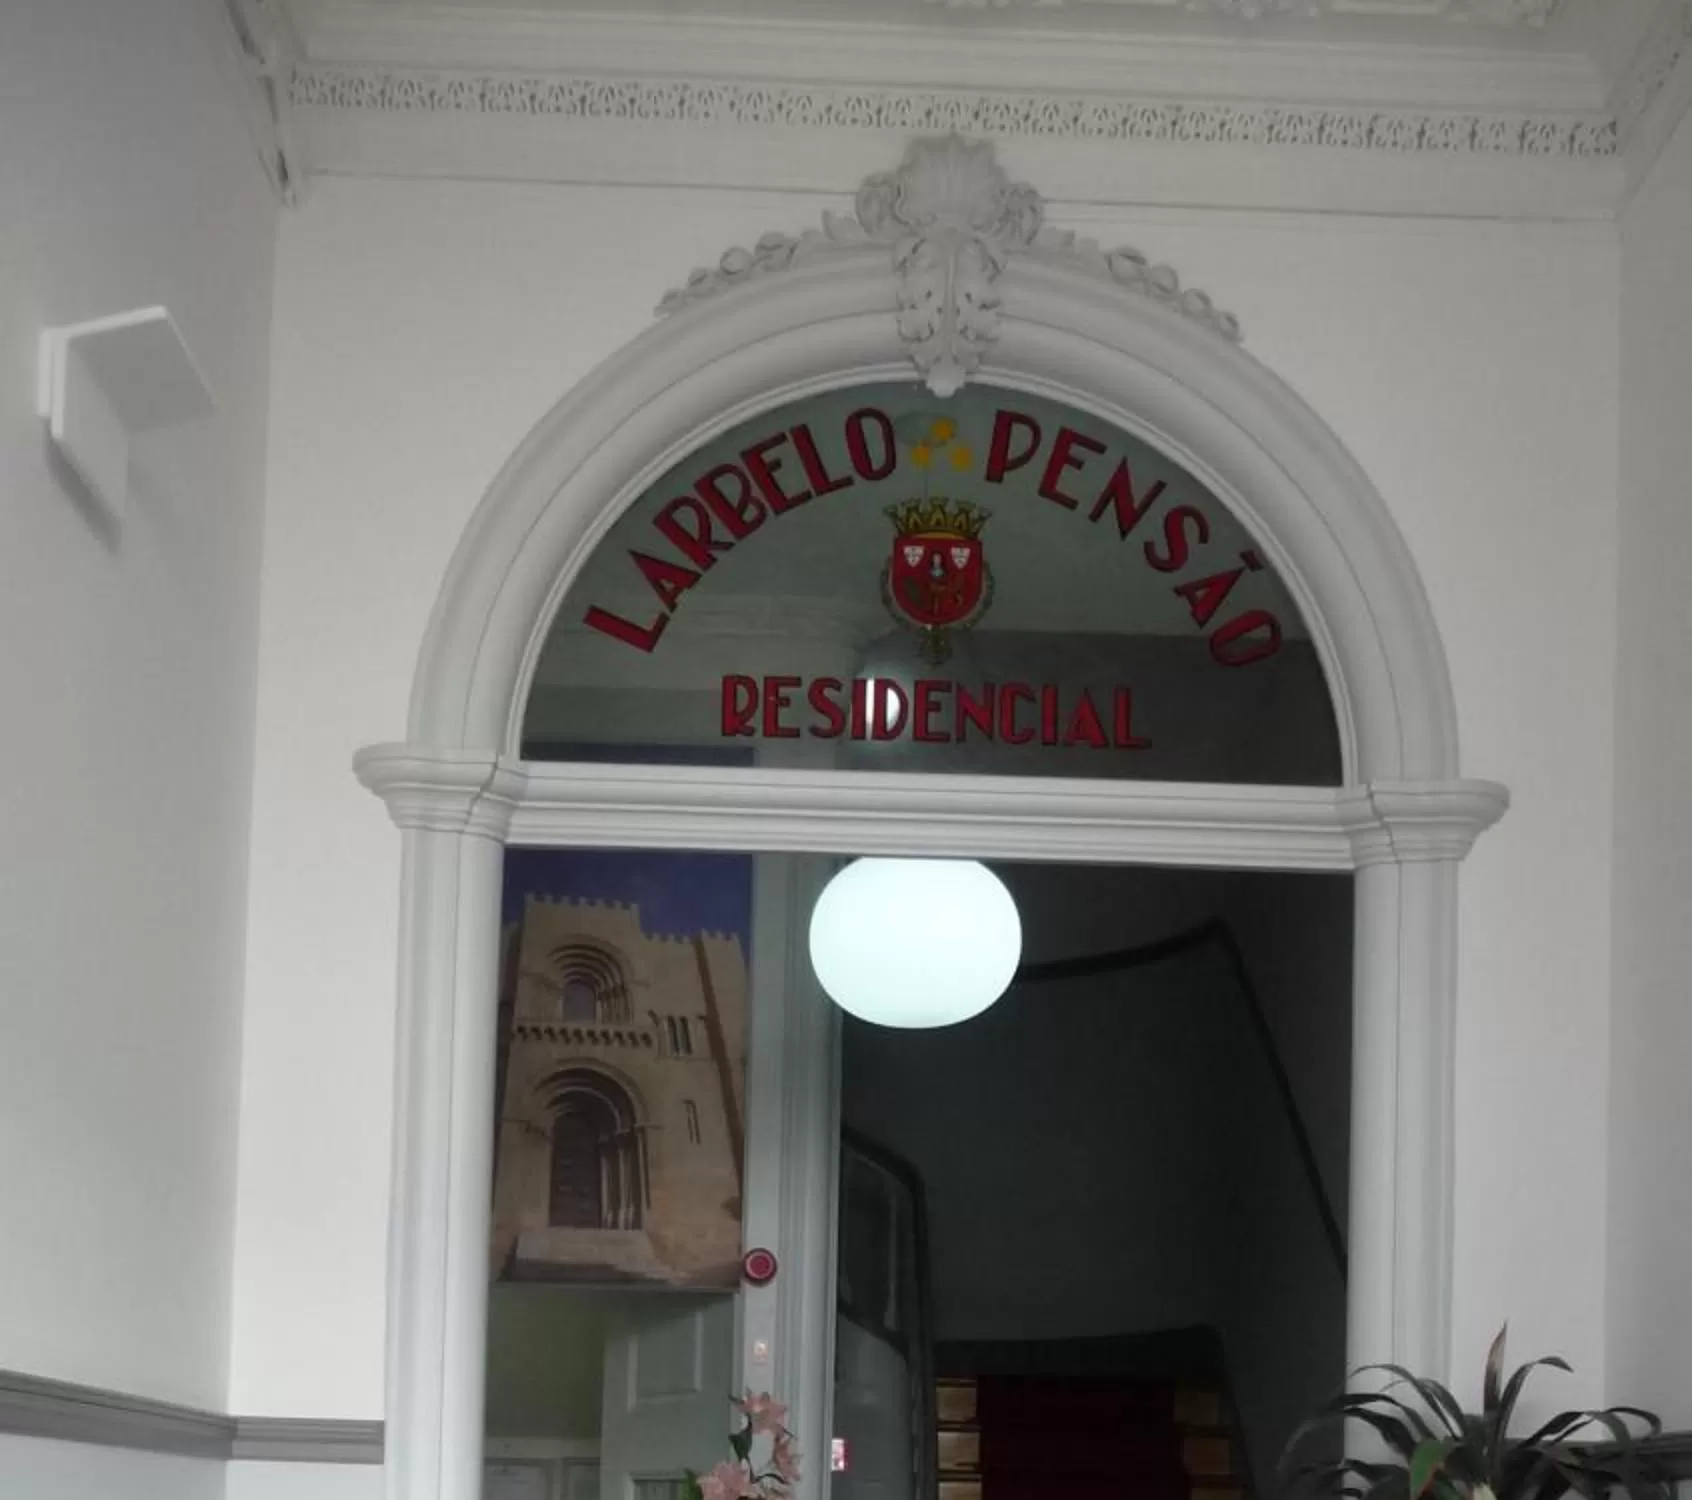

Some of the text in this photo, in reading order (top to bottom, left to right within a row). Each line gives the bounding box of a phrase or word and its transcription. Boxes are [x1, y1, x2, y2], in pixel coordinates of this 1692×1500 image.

[583, 407, 1282, 667] LARBELO PENSÃO
[721, 674, 1153, 749] RESIDENCIAL
